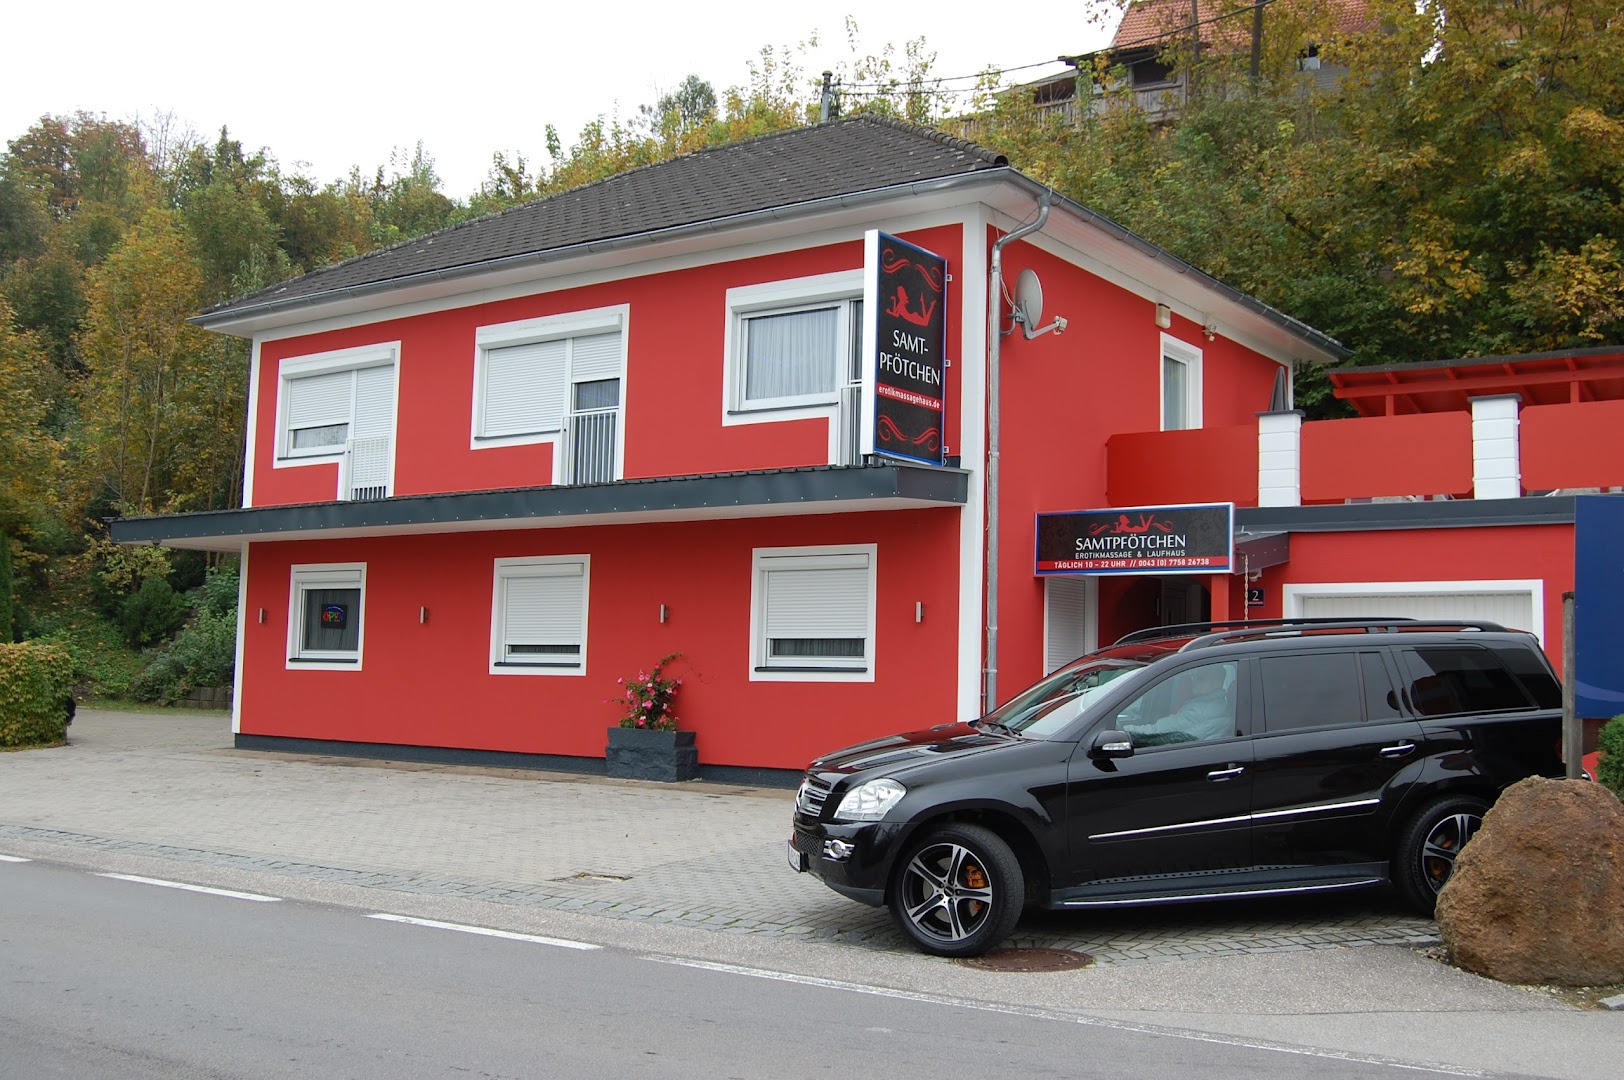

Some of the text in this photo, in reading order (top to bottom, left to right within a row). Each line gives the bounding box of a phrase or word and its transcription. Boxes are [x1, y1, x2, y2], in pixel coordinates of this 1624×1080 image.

[893, 329, 929, 354] SAMT-
[879, 351, 941, 386] PFÖTCHEN
[878, 386, 940, 408] erotikmassagehaus.de
[1075, 534, 1186, 550] SAMTPFÖTCHEN
[1075, 551, 1132, 560] EROTIKMASSAGE
[1146, 549, 1186, 558] LAUFHAUS
[1054, 560, 1083, 569] TÄGLICH
[1100, 560, 1110, 568] 22
[1110, 560, 1126, 568] UHR
[1138, 559, 1155, 567] 0043
[1169, 558, 1186, 566] 7758
[1187, 558, 1210, 566] 26738
[1252, 590, 1260, 601] 2
